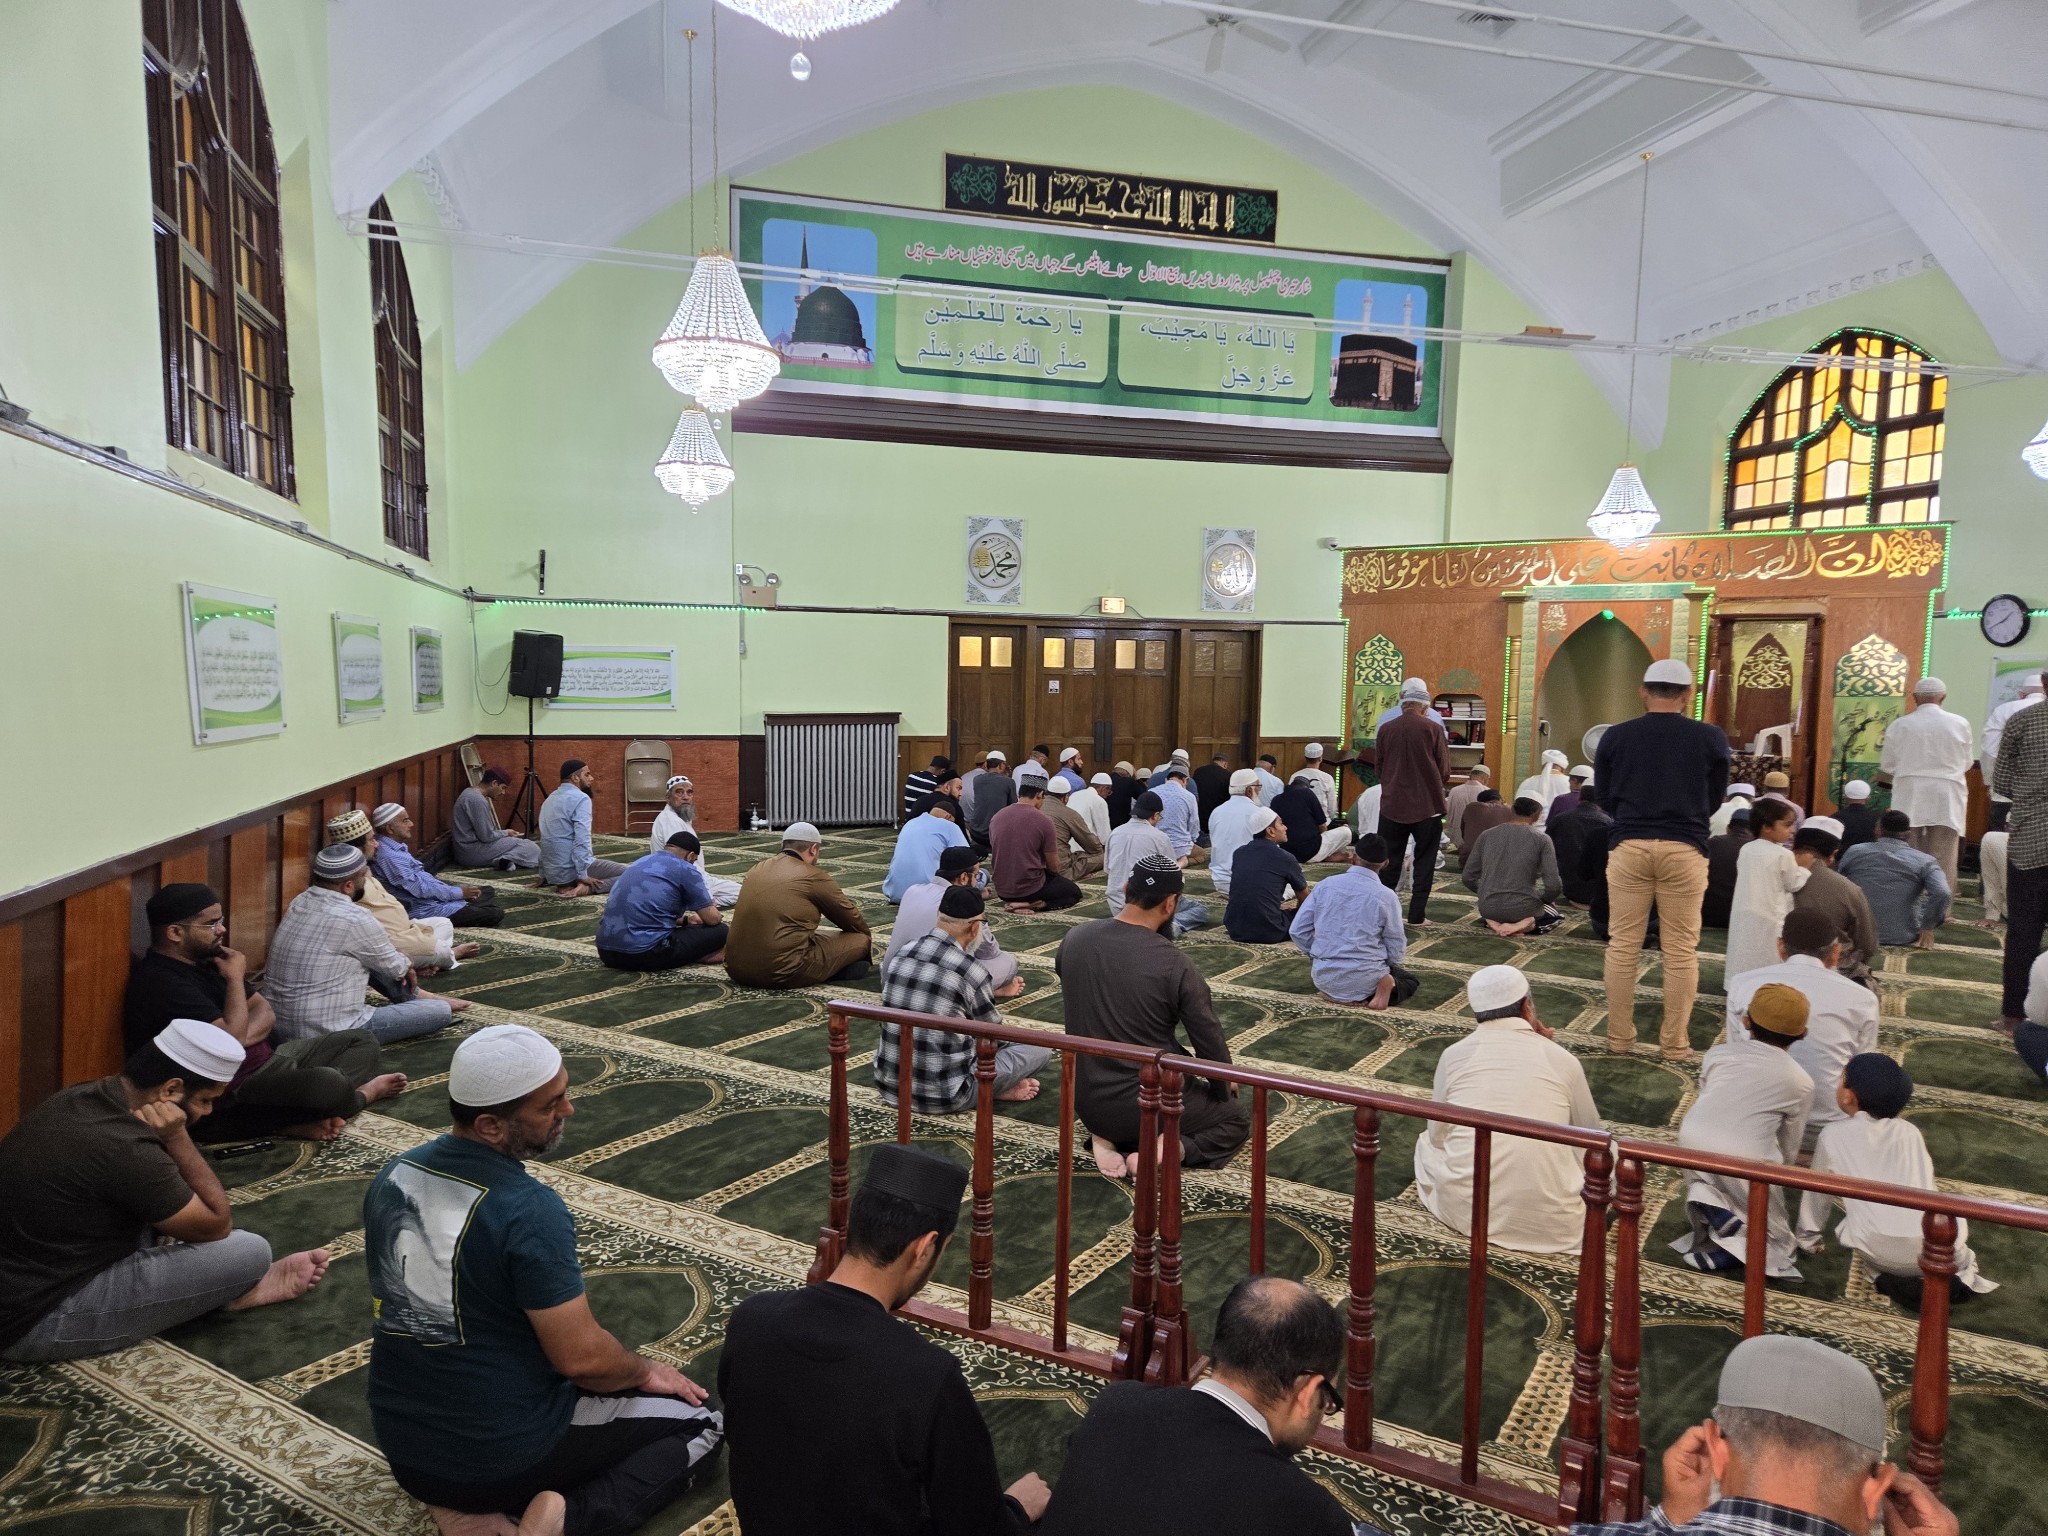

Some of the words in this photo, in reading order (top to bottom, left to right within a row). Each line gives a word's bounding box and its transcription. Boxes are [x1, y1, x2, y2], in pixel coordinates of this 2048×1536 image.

[1006, 171, 1039, 212] الله
[1042, 172, 1085, 217] رسول
[1084, 178, 1142, 219] محمد
[1103, 599, 1124, 611] ET
